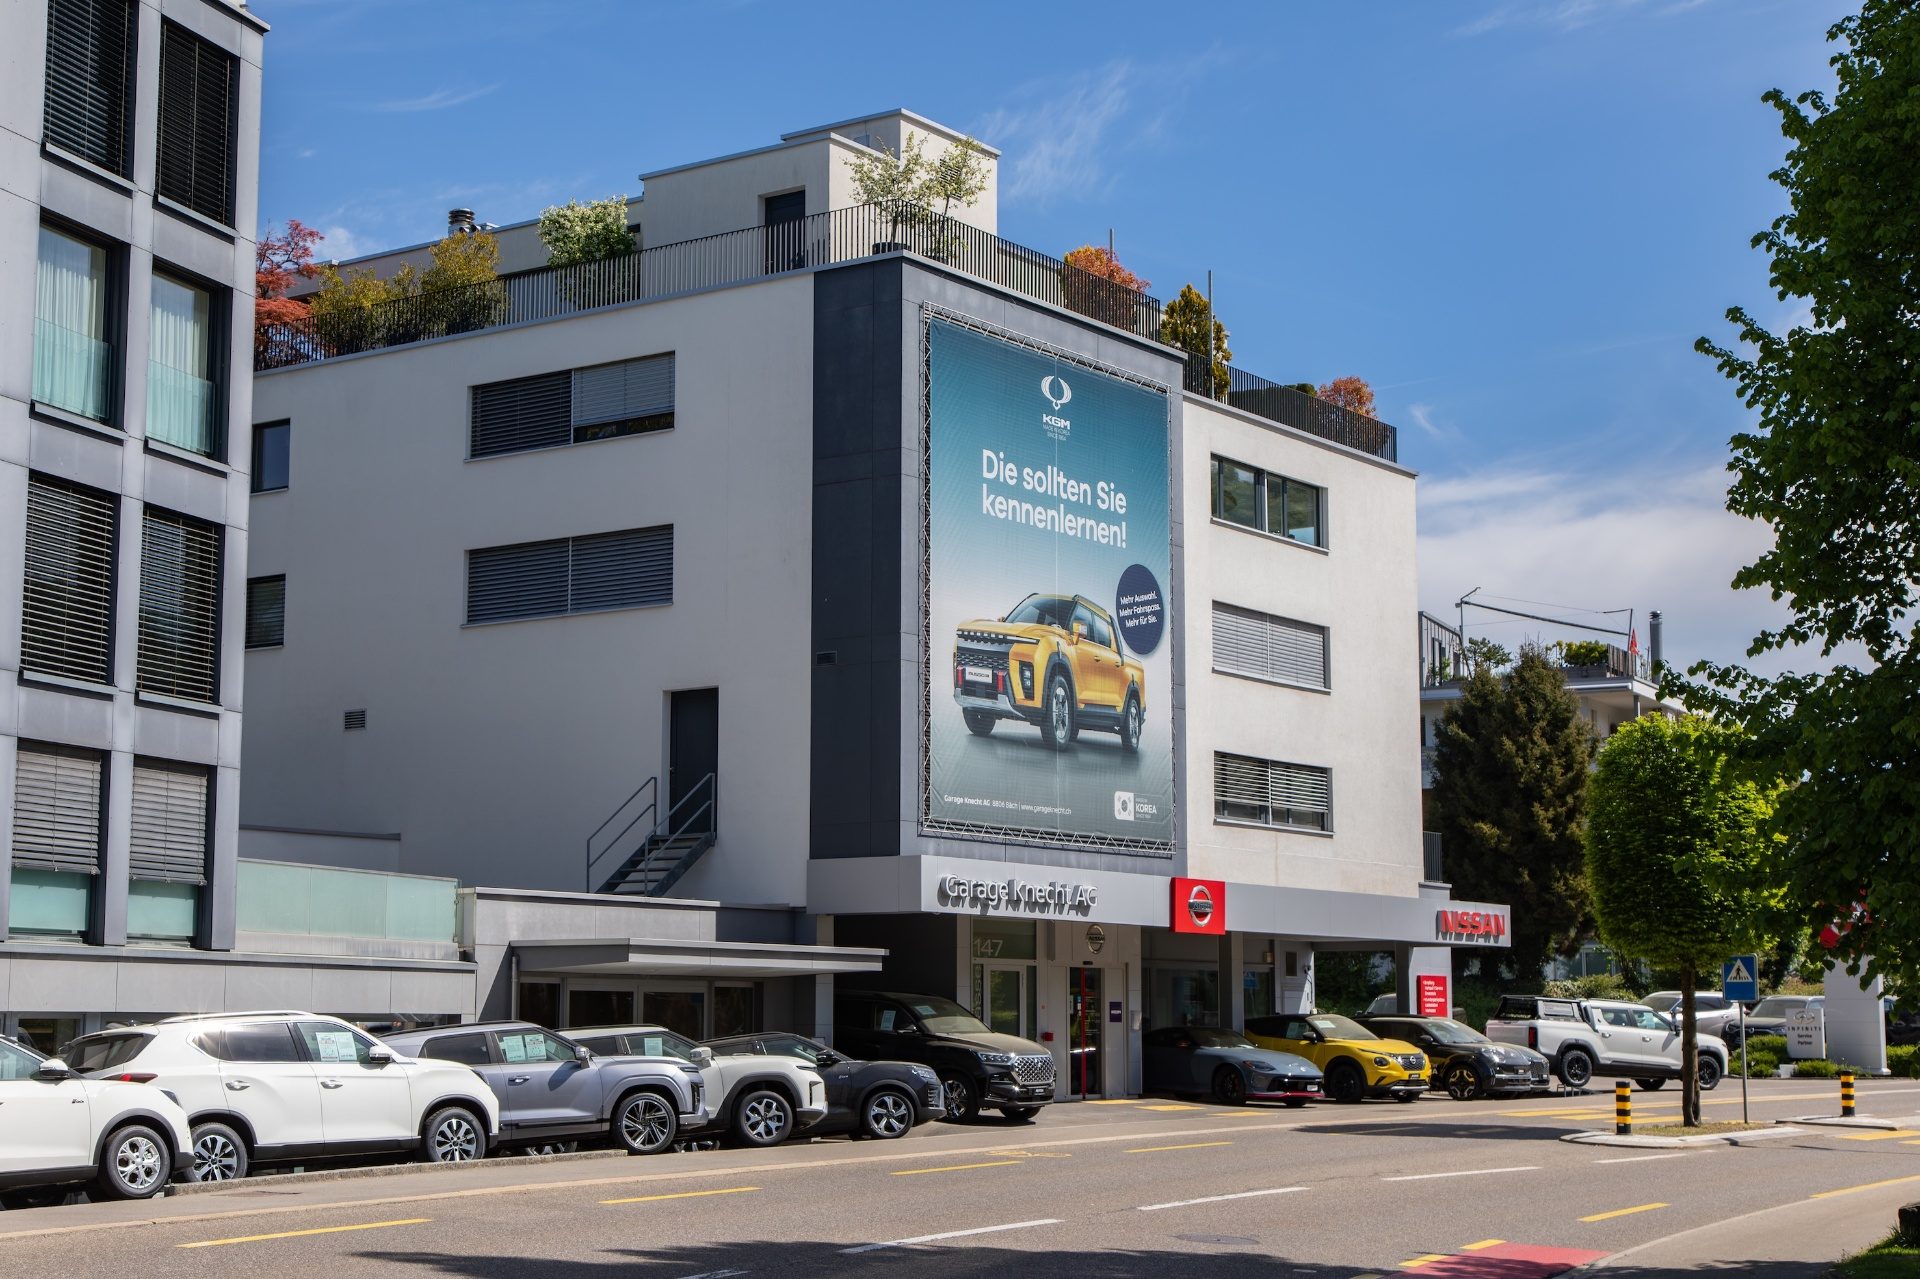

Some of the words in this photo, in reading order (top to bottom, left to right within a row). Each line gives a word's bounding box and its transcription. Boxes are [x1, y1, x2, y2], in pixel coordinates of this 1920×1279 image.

[1042, 413, 1070, 430] KGM
[982, 449, 1018, 485] Die
[1022, 465, 1092, 506] sollten
[1096, 481, 1127, 514] Sie
[982, 484, 1127, 549] kennenlernen!
[1120, 595, 1134, 605] Mehr
[1134, 591, 1158, 603] Auswahl.
[1119, 607, 1133, 617] Mehr
[1133, 604, 1161, 614] Fahrspass.
[1125, 618, 1139, 628] Mehr
[1139, 615, 1148, 626] für
[1148, 614, 1158, 624] Sie.
[943, 794, 964, 805] Garage
[964, 798, 982, 806] Knecht
[982, 799, 991, 807] AG
[1021, 803, 1072, 816] www.garageknecht.ch
[1135, 803, 1158, 815] KOREA
[945, 874, 1009, 905] Garage
[1013, 879, 1072, 906] Knecht
[1075, 885, 1099, 907] AG
[1441, 910, 1506, 936] NISSAN
[973, 938, 1004, 958] 147
